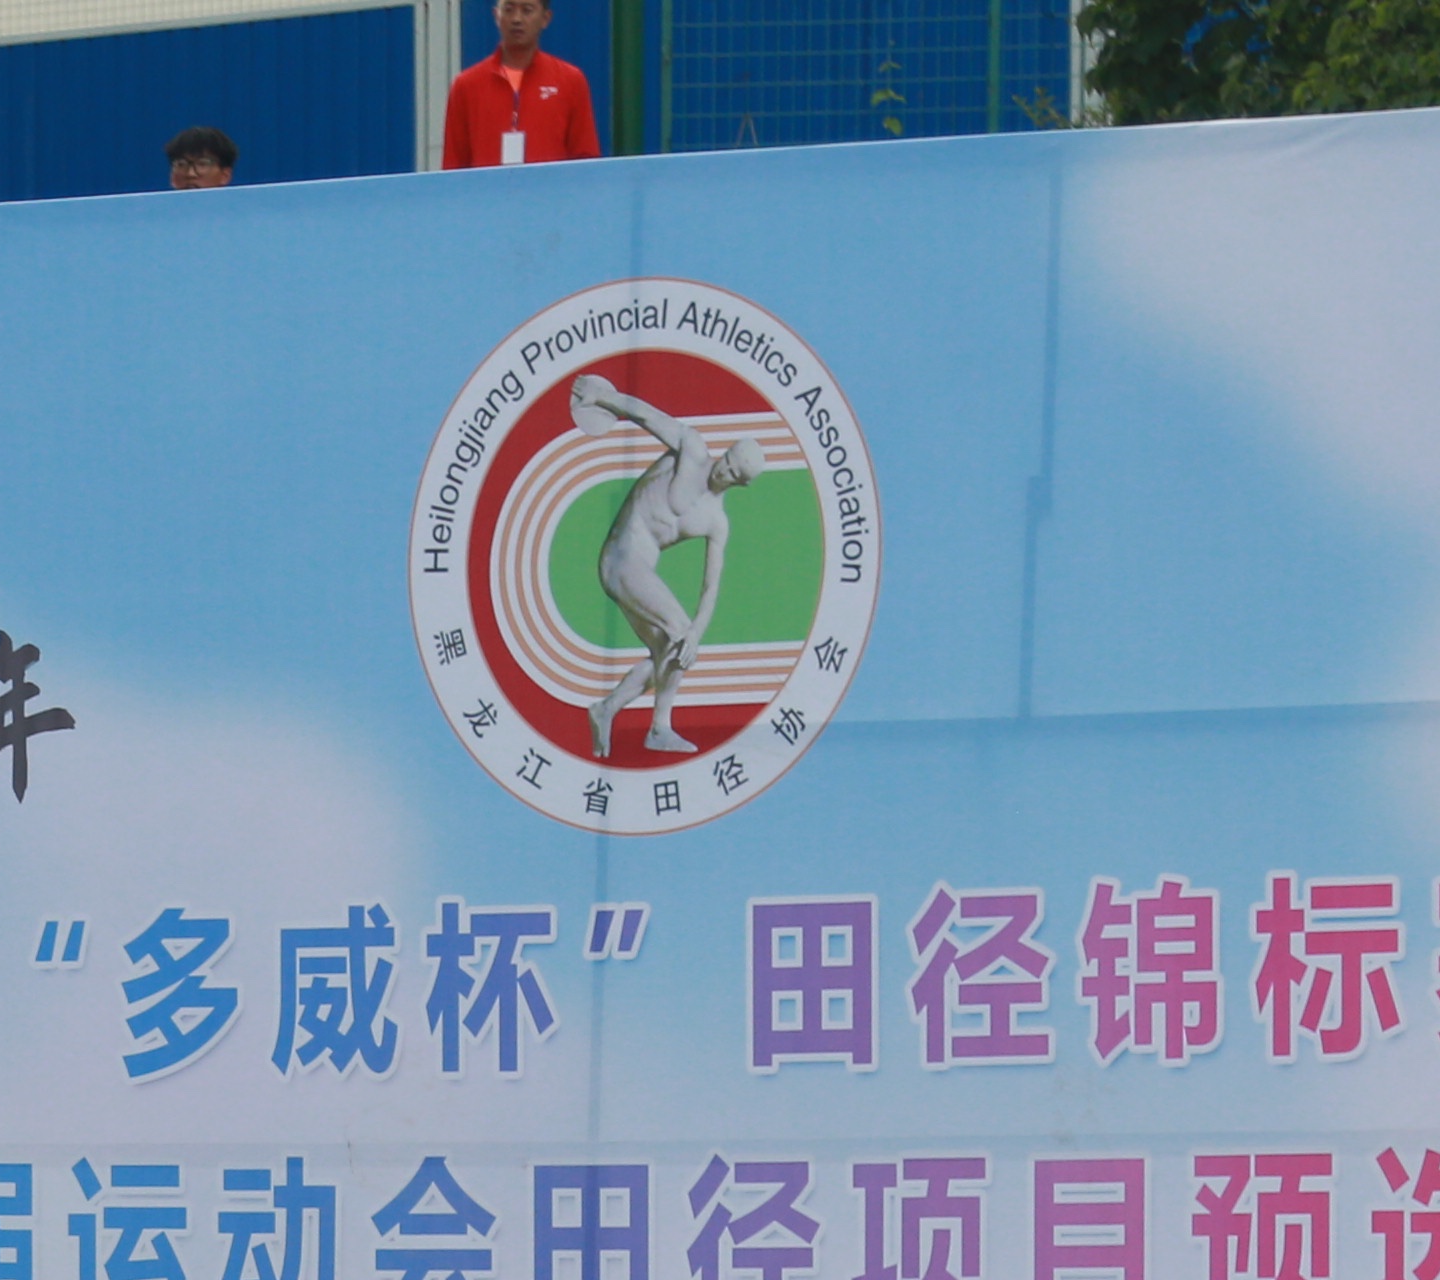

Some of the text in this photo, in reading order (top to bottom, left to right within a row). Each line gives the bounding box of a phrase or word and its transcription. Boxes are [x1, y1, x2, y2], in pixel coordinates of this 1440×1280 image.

[424, 298, 863, 585] Heilongjiang Provincial Athletics Association
